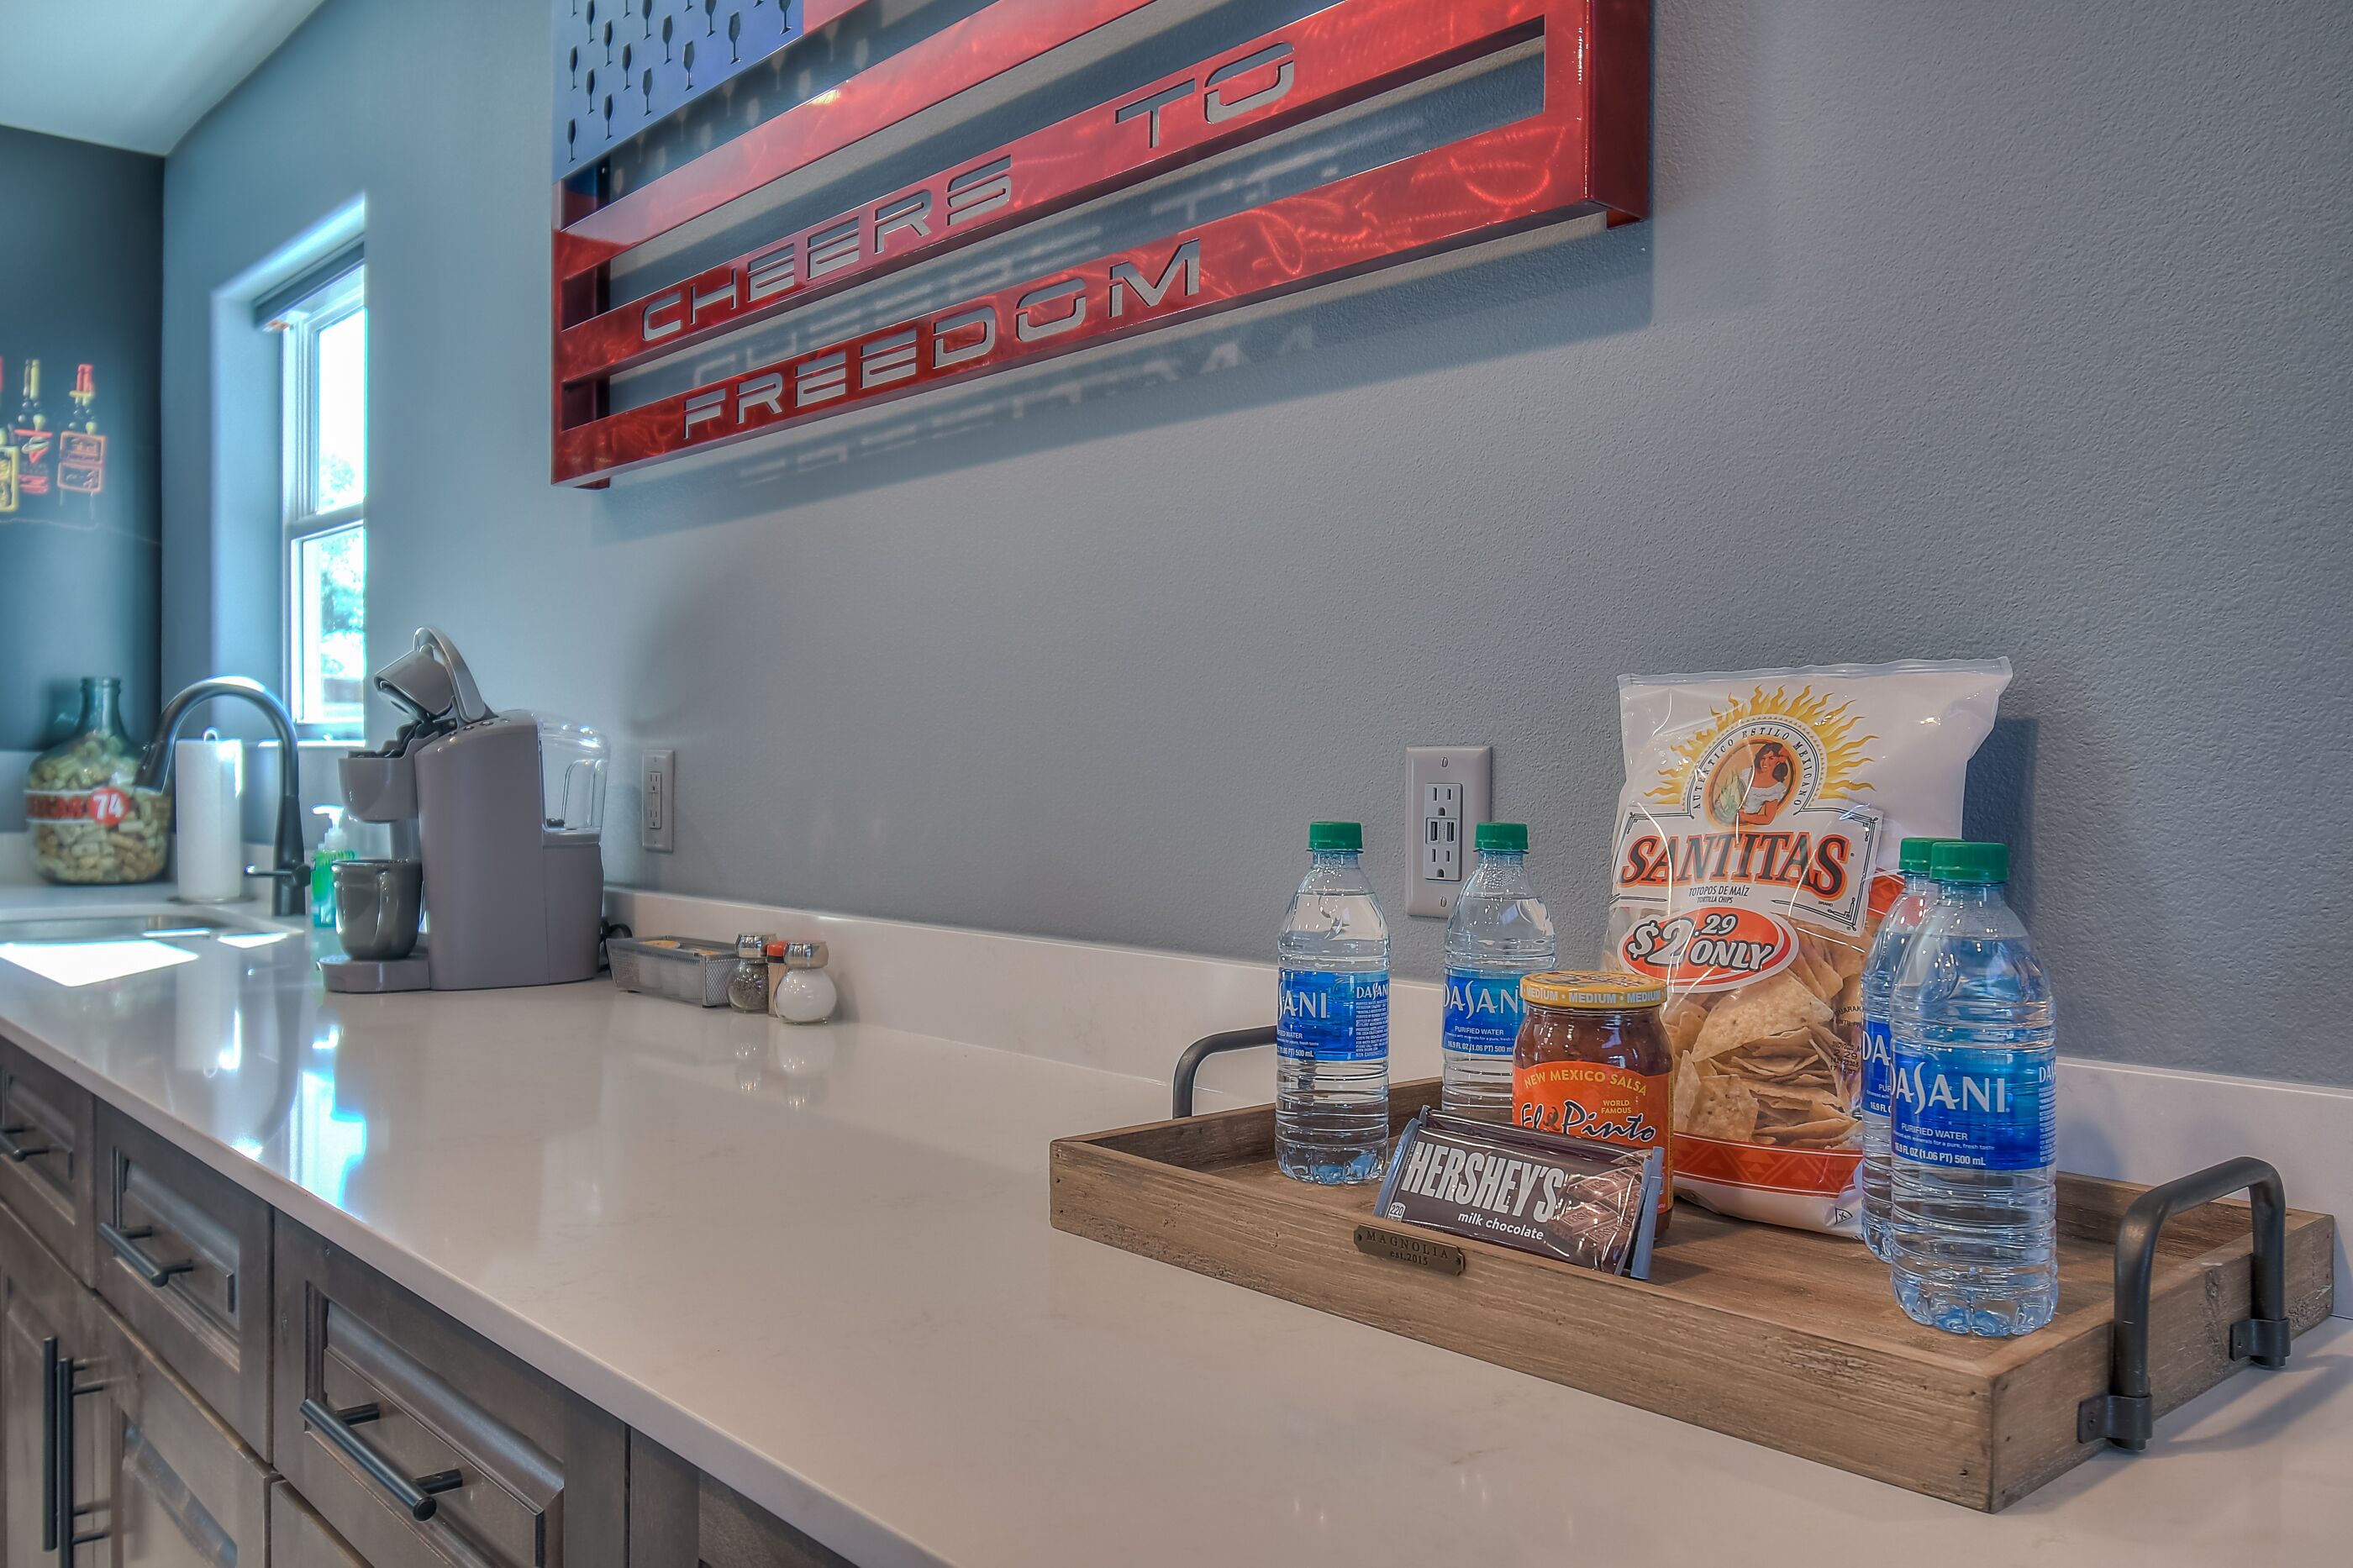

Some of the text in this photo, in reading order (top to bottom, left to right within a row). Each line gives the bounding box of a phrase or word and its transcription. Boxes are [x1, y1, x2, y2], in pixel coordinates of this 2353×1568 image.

[643, 42, 1294, 342] CHEERS TO
[683, 239, 1199, 439] FREEDOM
[1742, 727, 1790, 740] ESTILO
[1792, 741, 1813, 806] MEXICANO
[93, 792, 124, 819] 74
[1620, 831, 1850, 899] SANTITAS
[1689, 884, 1750, 897] TOTOPOS DE MAÍZ
[1689, 939, 1774, 971] ONLY
[1527, 986, 1661, 1004] MEDIUM MEDIUM MEDIUM
[1455, 1026, 1480, 1035] PURIFIED
[1455, 1041, 1461, 1050] FL
[1524, 1069, 1646, 1096] NEW MEXICO SALSA
[1891, 1062, 2006, 1115] DASANI
[1520, 1099, 1656, 1142] El Pinto
[1880, 1103, 1887, 1113] FL
[1901, 1123, 1934, 1136] PURIFIED
[1935, 1129, 1968, 1140] WATER
[1909, 1147, 1919, 1158] OZ
[1919, 1150, 1939, 1160] (1.06
[1940, 1153, 1953, 1164] PT)
[1954, 1155, 1970, 1165] 500
[1972, 1157, 1986, 1165] mL
[1401, 1141, 1565, 1223] HERSHEY'S
[1390, 1204, 1404, 1217] 220
[1457, 1212, 1545, 1240] milk chocolate
[1366, 1230, 1448, 1259] MAGNOLIA
[1390, 1251, 1429, 1265] est.2015
